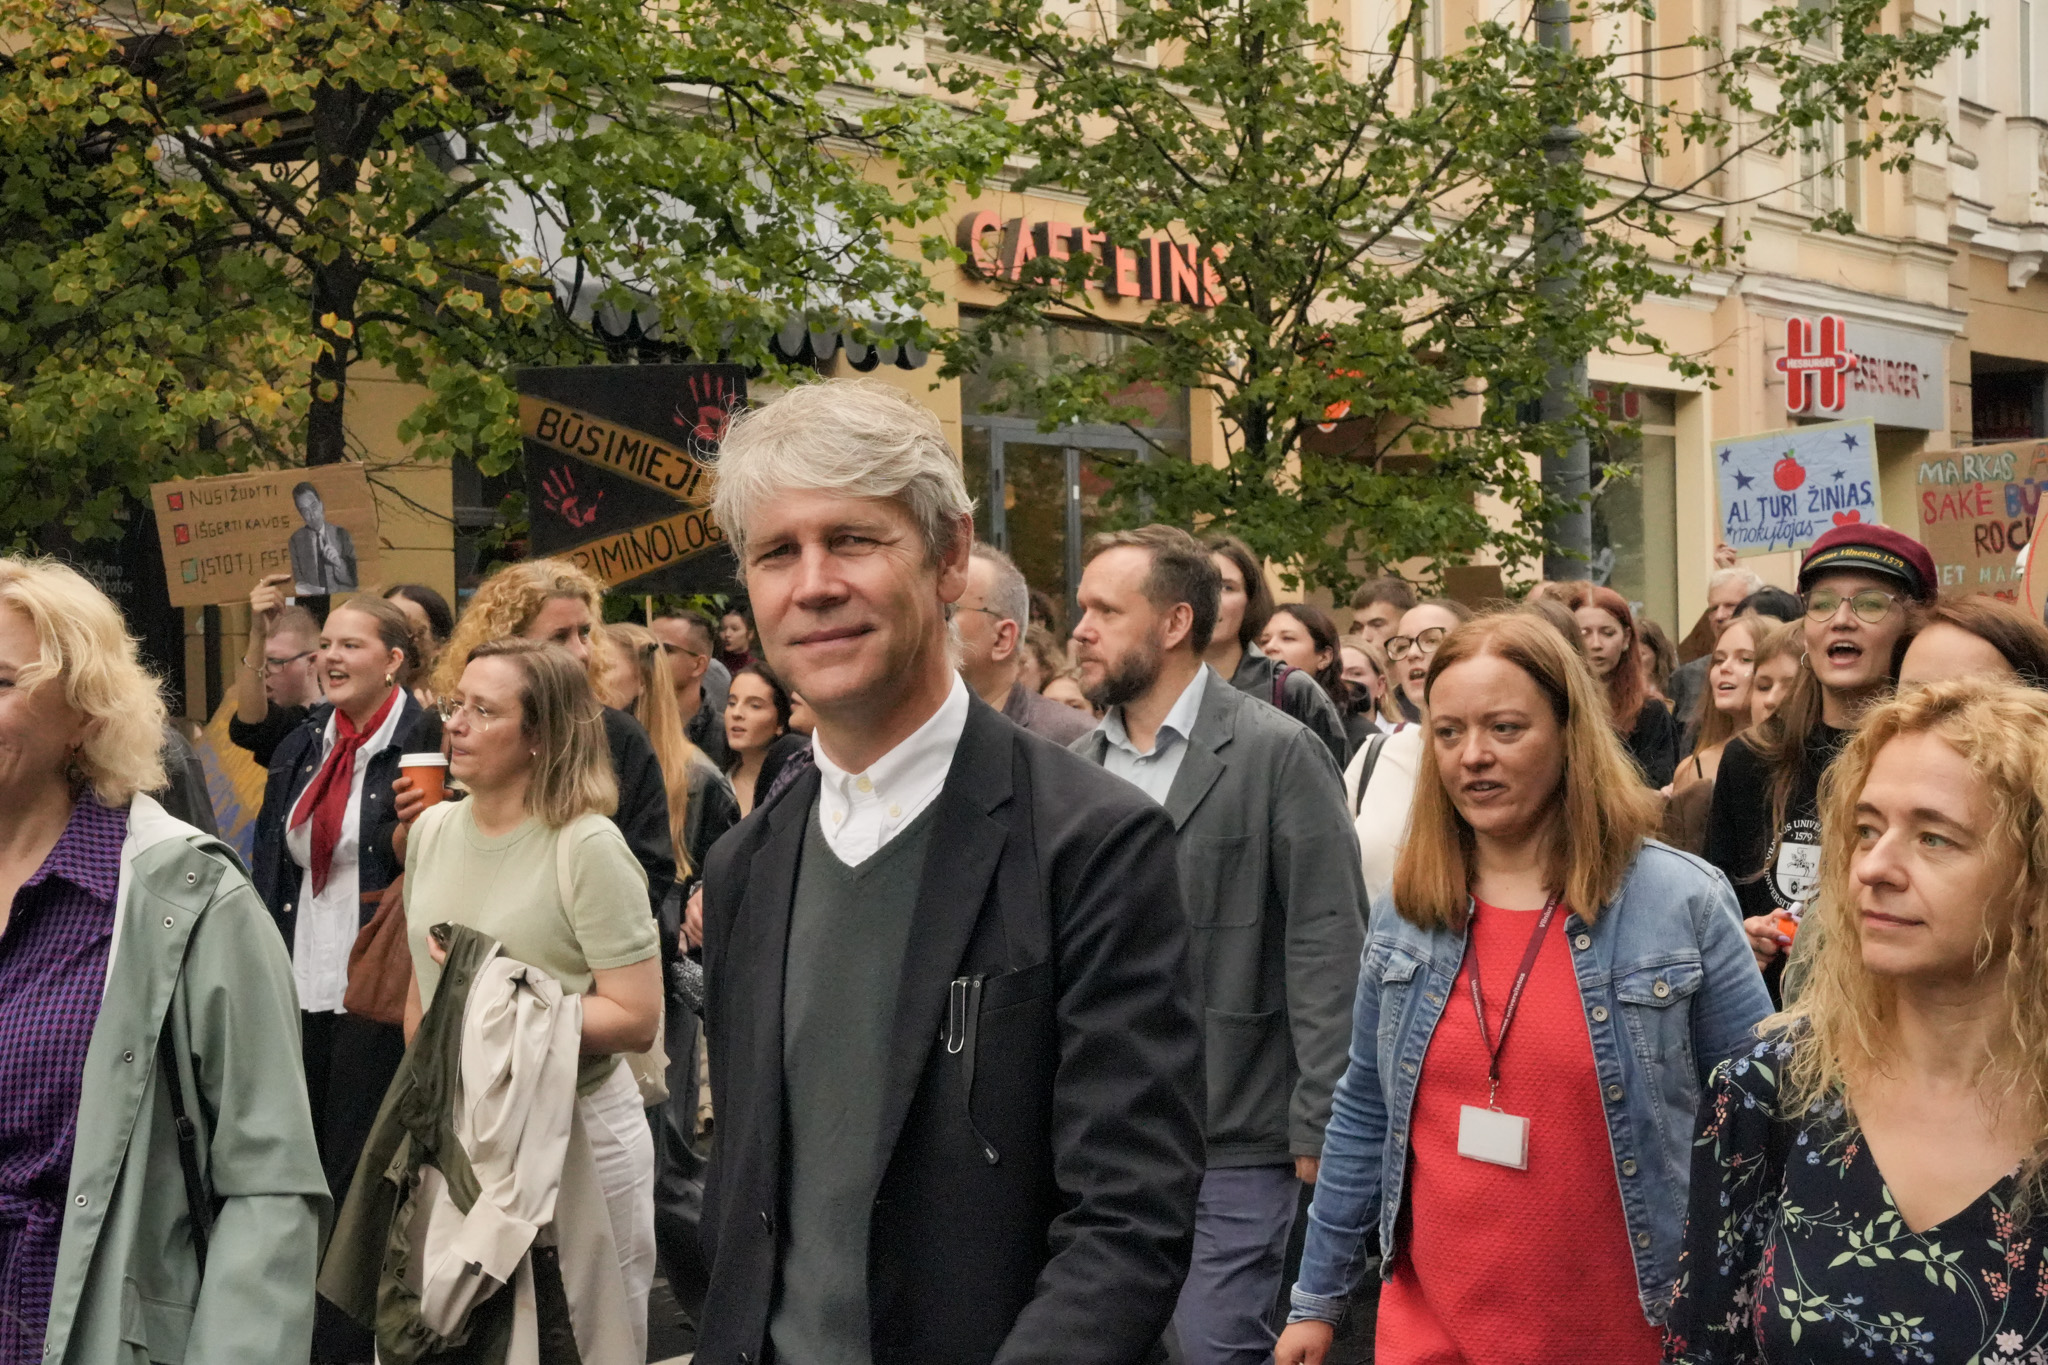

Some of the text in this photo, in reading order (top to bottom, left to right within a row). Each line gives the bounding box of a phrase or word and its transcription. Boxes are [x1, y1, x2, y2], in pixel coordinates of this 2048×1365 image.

[1786, 356, 1836, 369] HESBURGER
[1850, 348, 1920, 399] ESBURGER
[536, 406, 703, 497] BŪSIMIEJI
[1917, 450, 2017, 485] MARKAS
[190, 484, 278, 507] NUSIŽUDYTI
[1757, 492, 1798, 521] TURI
[1808, 481, 1875, 514] ŽINIAS,
[1922, 473, 2048, 524] SAKĖ BŪ
[245, 514, 290, 531] KAVOS
[1883, 554, 1905, 569] 1579
[1794, 831, 1813, 842] 1579
[1763, 867, 1793, 910] UNIVERSIT
[1538, 905, 1554, 928] Vilnius
